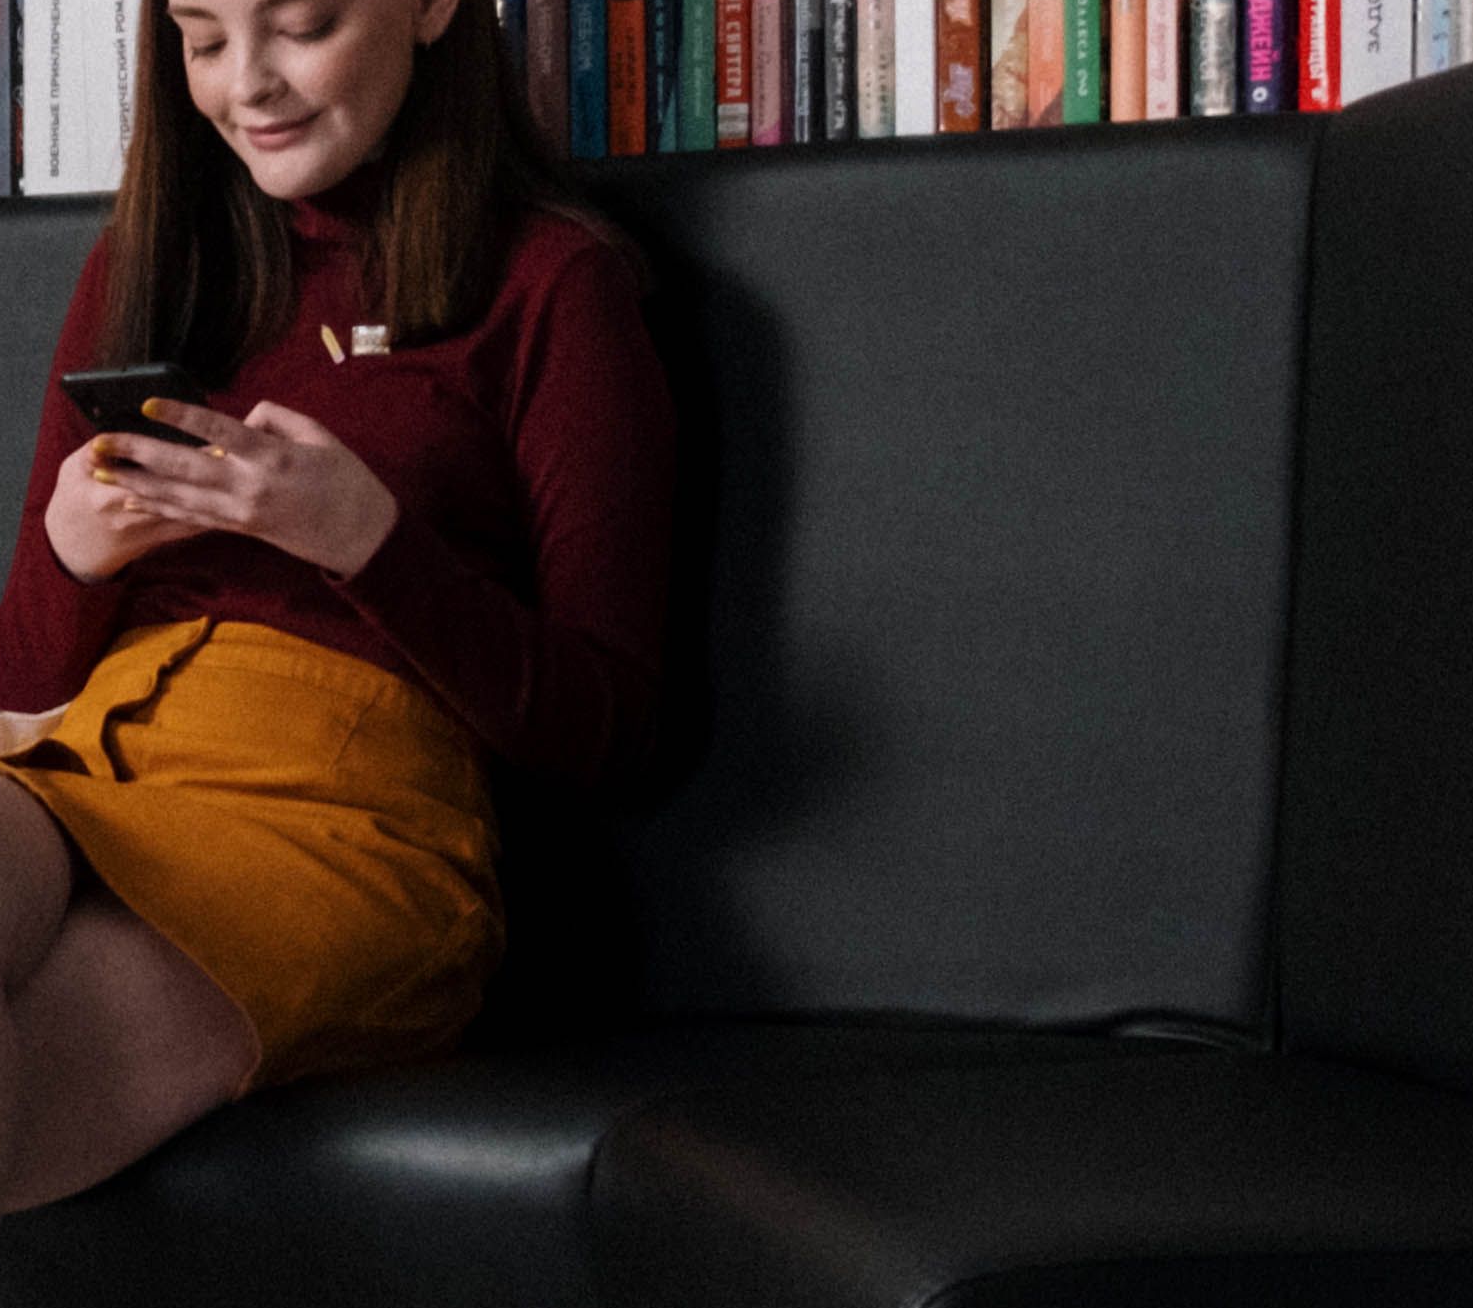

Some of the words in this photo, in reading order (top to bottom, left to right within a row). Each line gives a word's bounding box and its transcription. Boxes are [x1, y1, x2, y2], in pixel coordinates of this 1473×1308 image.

[538, 6, 553, 76] НЕБОМ
[577, 2, 593, 72] НЕБОМ
[50, 103, 60, 178] ВОЕННЫЕ
